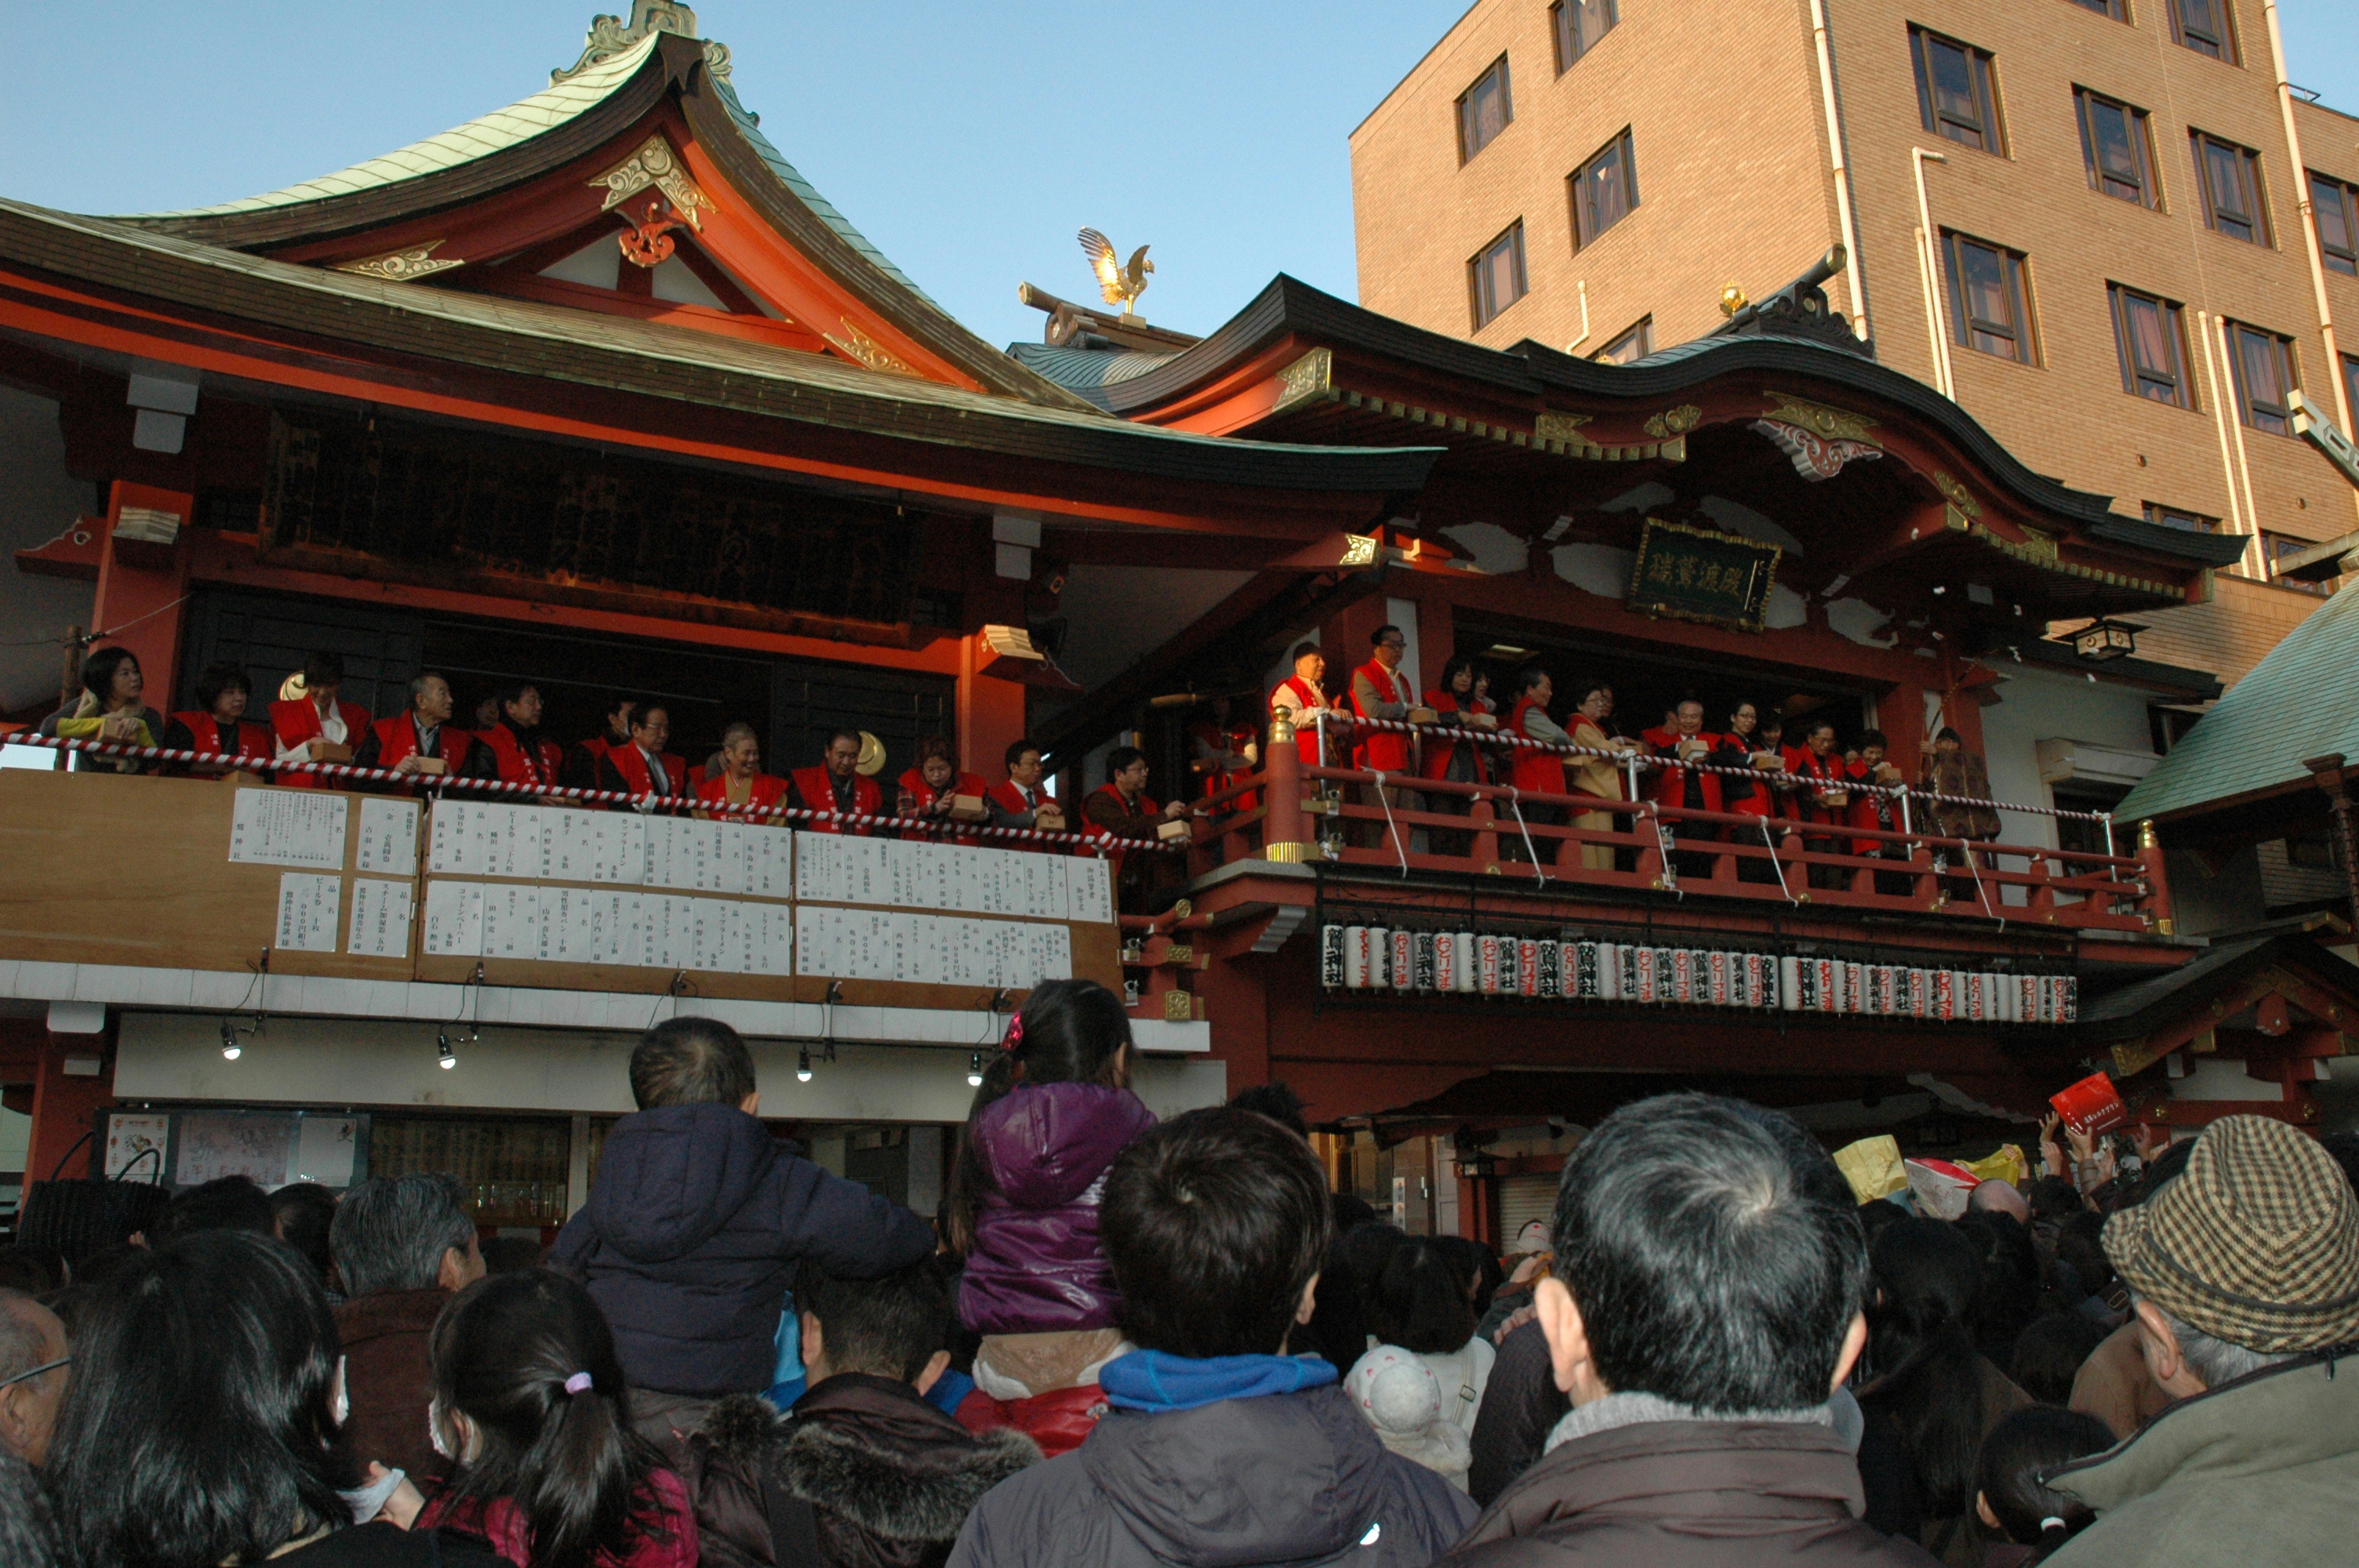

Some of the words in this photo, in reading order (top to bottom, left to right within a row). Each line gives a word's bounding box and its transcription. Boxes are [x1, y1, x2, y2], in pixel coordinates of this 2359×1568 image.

[1436, 936, 1452, 989] おとりさま
[1482, 938, 1497, 993] おとりさま
